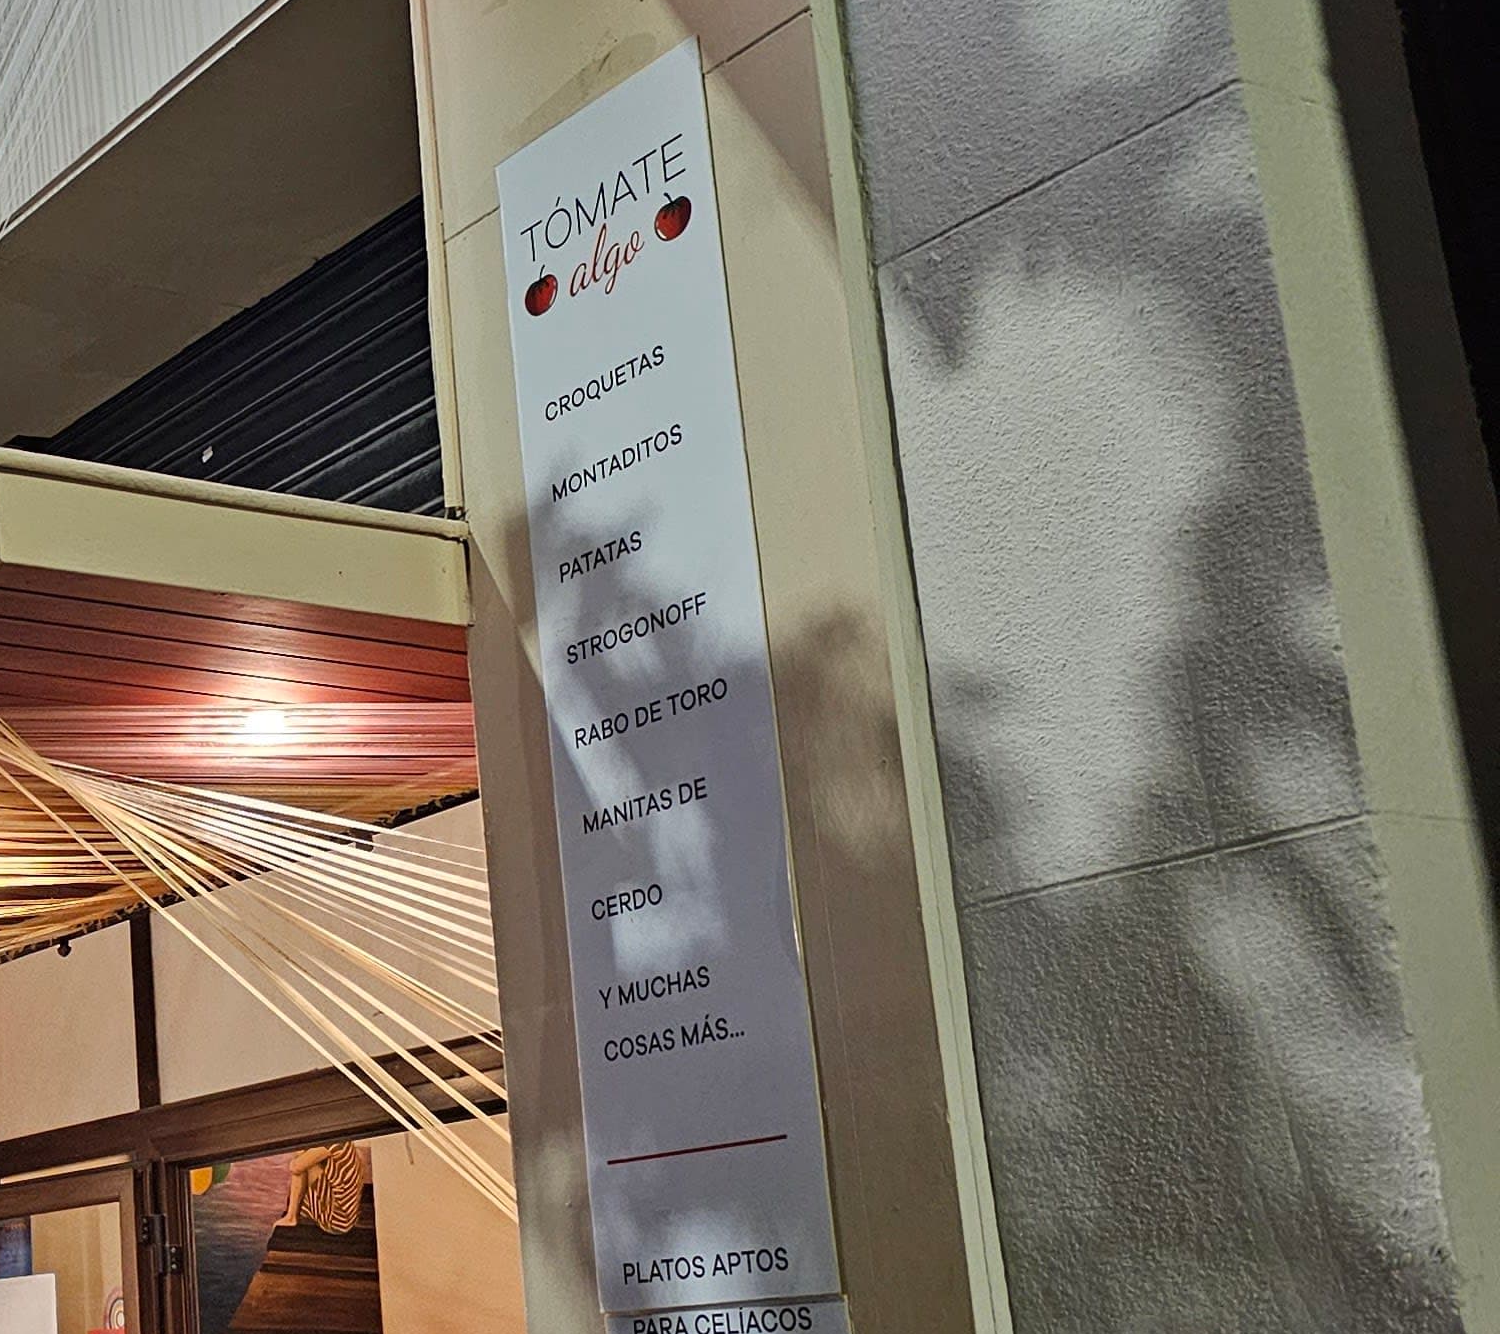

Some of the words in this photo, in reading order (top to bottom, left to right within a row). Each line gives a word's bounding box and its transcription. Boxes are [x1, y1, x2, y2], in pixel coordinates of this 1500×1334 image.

[520, 133, 686, 263] TÓMATE
[569, 223, 644, 297] algo
[544, 344, 666, 423] CROQUETAS
[551, 423, 684, 504] MONTADITOS
[558, 530, 643, 585] PATATAS
[565, 592, 707, 666] STROGONOFF
[574, 711, 630, 750] RABO
[634, 699, 663, 729] DE
[665, 677, 729, 717] TORO
[582, 788, 673, 835] MANITAS
[678, 777, 709, 805] DE
[591, 883, 663, 922] CERDO
[598, 987, 614, 1011] Y
[618, 965, 711, 1008] MUCHAS
[603, 1028, 676, 1063] COSAS
[680, 1014, 746, 1049] MÁS...
[622, 1254, 706, 1286] PLATOS
[711, 1247, 790, 1278] APTOS
